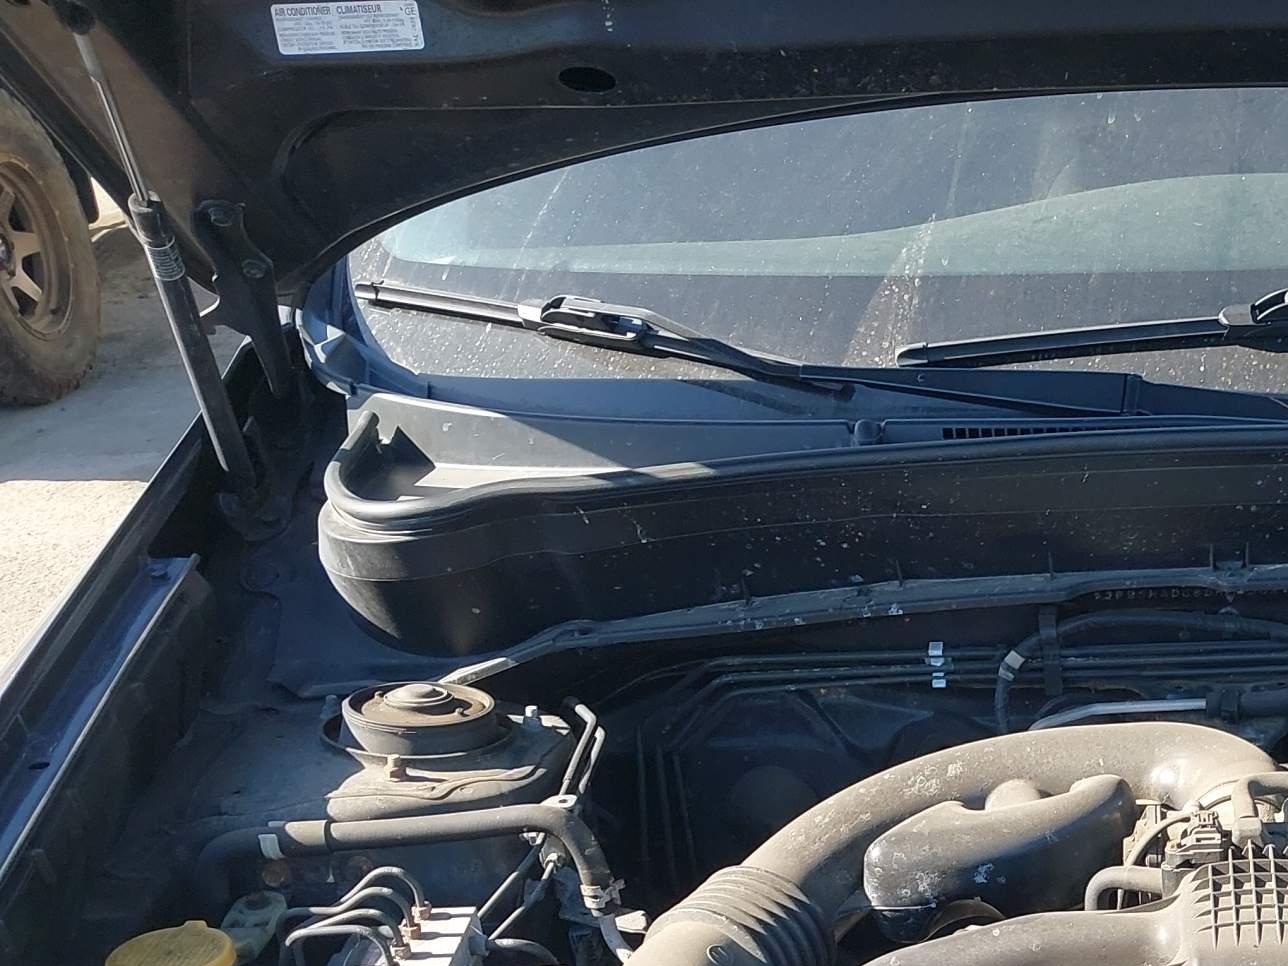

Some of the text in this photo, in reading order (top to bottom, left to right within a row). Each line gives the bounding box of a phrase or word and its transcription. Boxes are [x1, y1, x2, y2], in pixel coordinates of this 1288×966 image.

[274, 4, 382, 17] AIR CONDITIONER CLIMATISEUR
